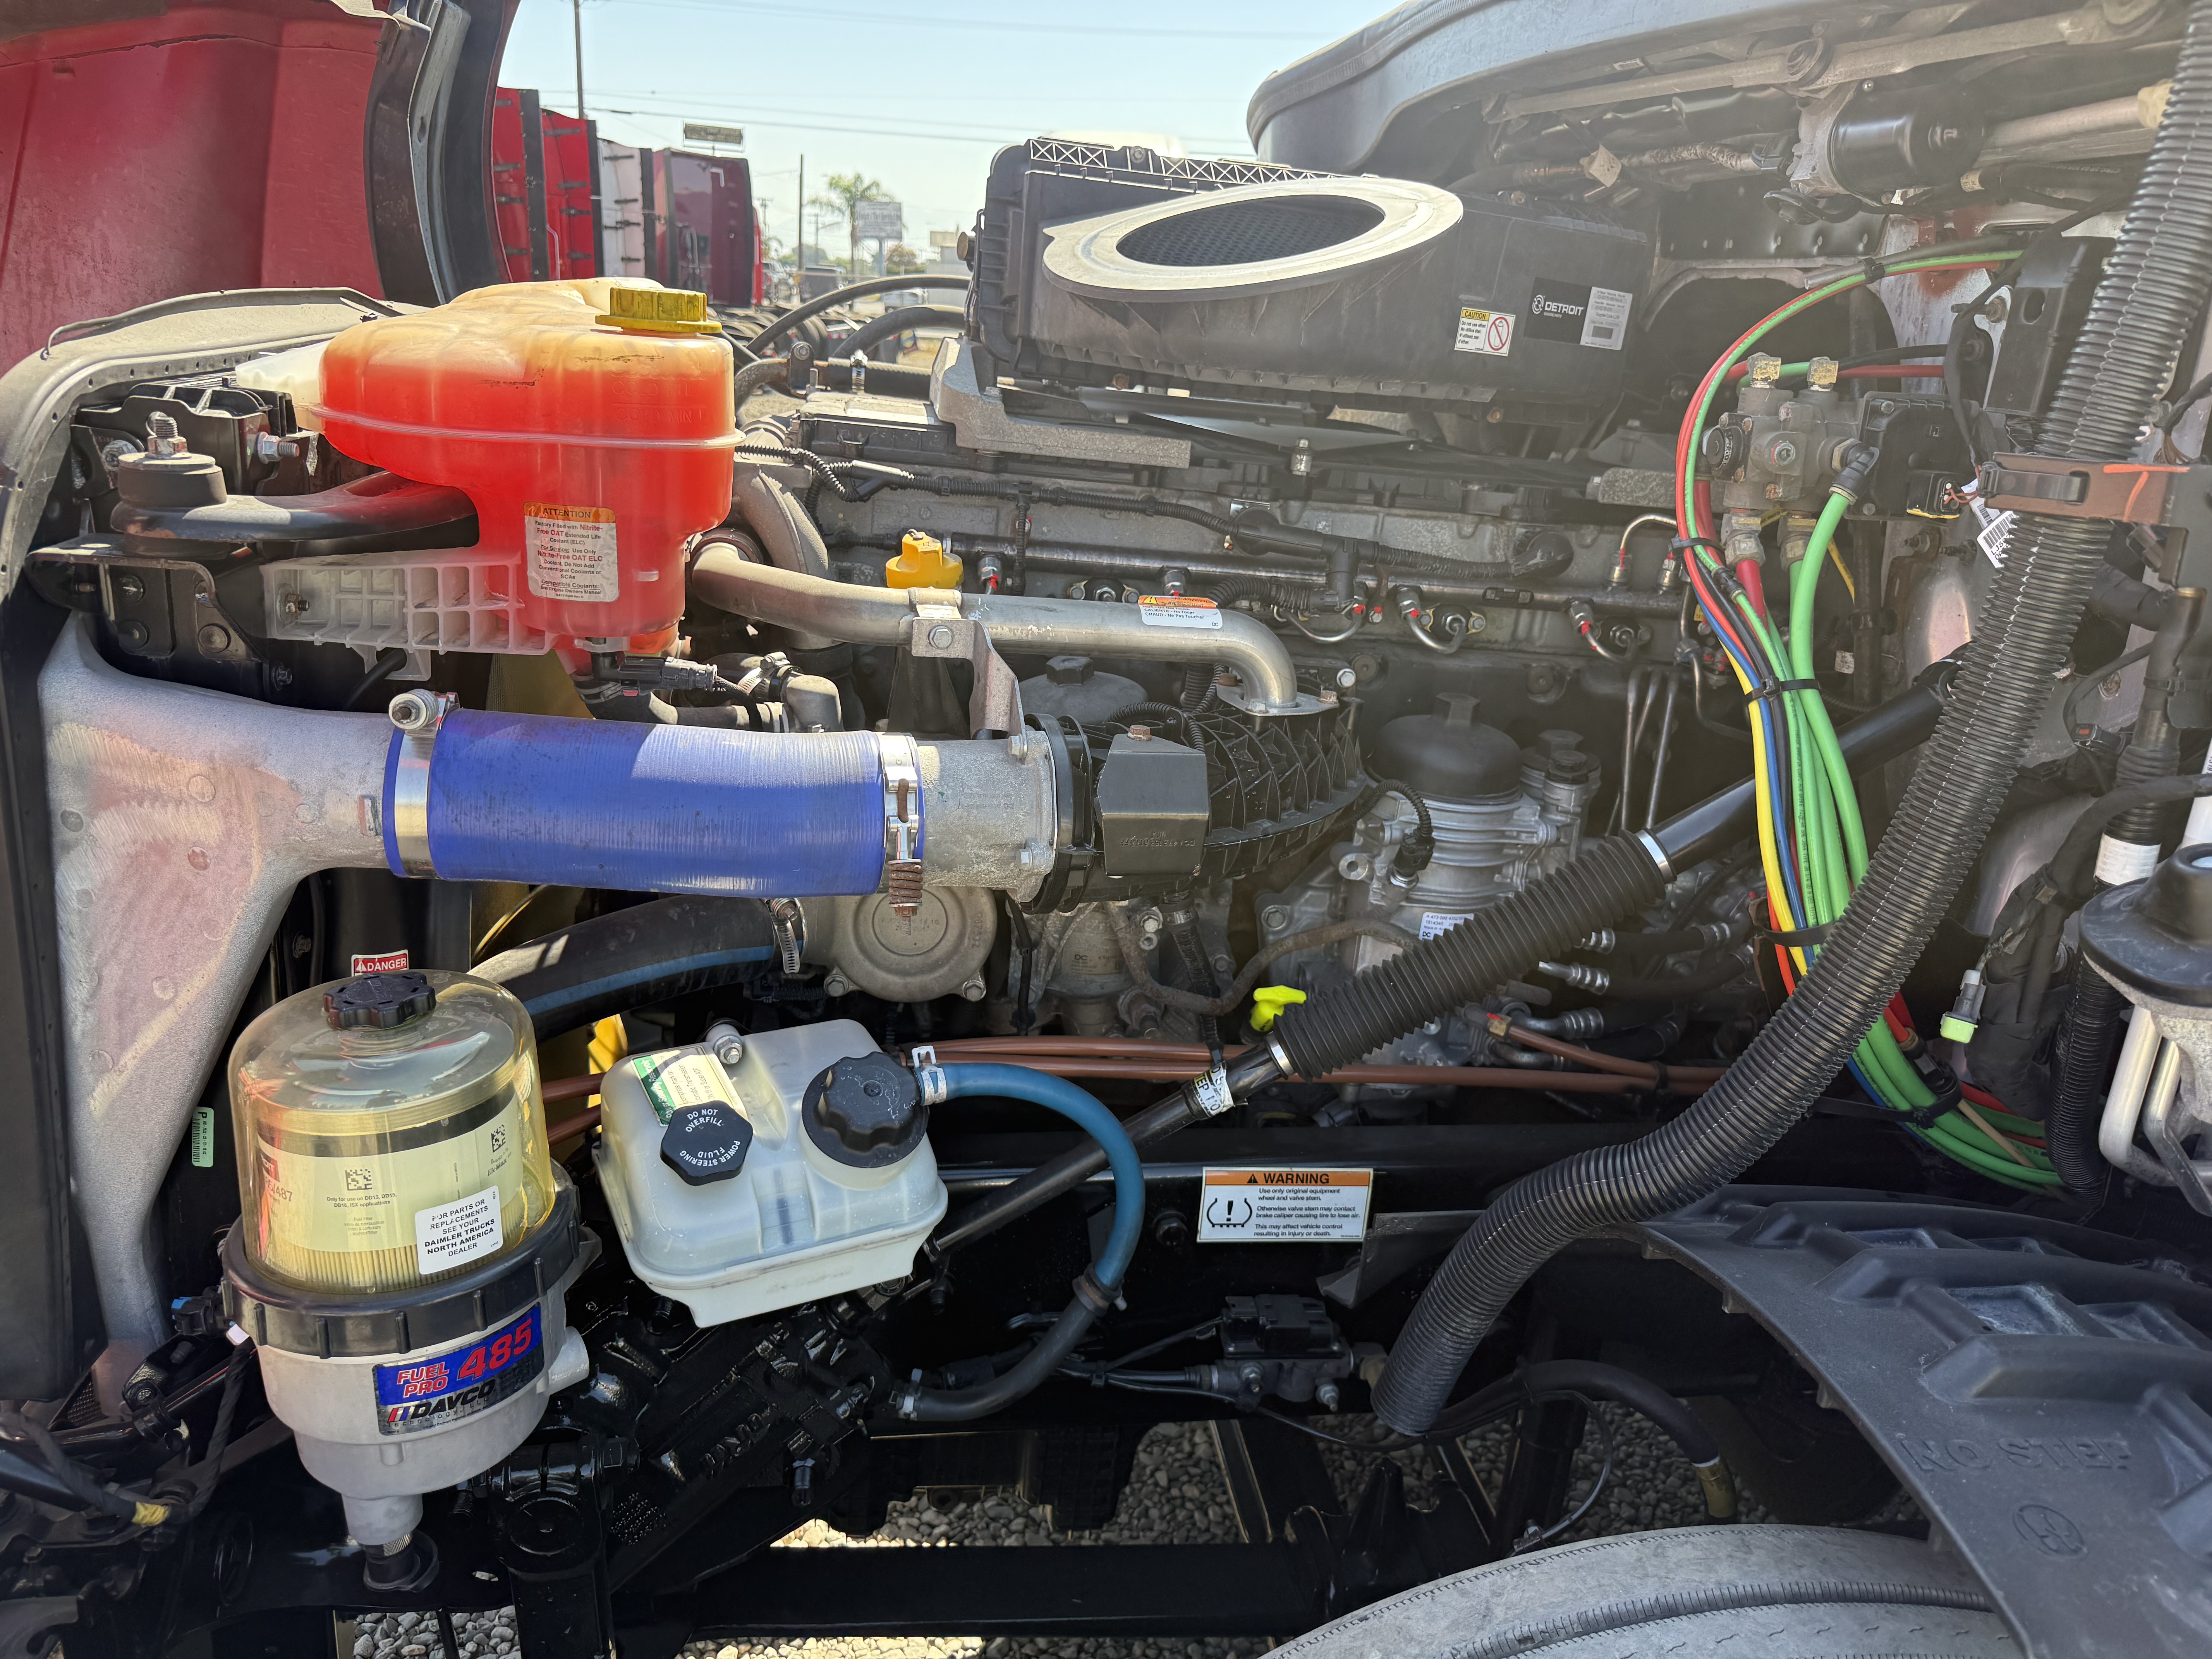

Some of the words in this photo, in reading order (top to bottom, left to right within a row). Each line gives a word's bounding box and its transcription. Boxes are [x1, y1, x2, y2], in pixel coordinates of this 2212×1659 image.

[1465, 311, 1486, 319] CAUTION
[1544, 302, 1585, 316] DETROIT
[543, 508, 591, 518] ATTENTION
[368, 958, 406, 971] DANGER
[653, 1081, 668, 1102] Steering
[687, 1111, 699, 1120] DO
[680, 1151, 718, 1166] STEERING
[698, 1147, 725, 1158] FLUID
[719, 1141, 740, 1162] POWER
[1264, 1173, 1329, 1184] WARNING
[430, 1206, 488, 1230] REPLACEMENTS
[432, 1213, 448, 1221] FOR
[450, 1204, 473, 1216] PARTS
[425, 1232, 462, 1247] DAIMLER
[464, 1219, 495, 1235] TRUCKS
[443, 1226, 457, 1234] SEE
[459, 1218, 479, 1229] YOUR
[427, 1242, 457, 1254] NORTH
[460, 1228, 494, 1245] AMERICA
[448, 1243, 477, 1257] DEALER
[397, 1362, 450, 1384] FUEL
[457, 1318, 532, 1380] 485
[404, 1376, 448, 1398] PRO
[410, 1379, 496, 1419] DAVCO
[1897, 1439, 1992, 1471] NO
[1997, 1437, 2131, 1471] STEP
